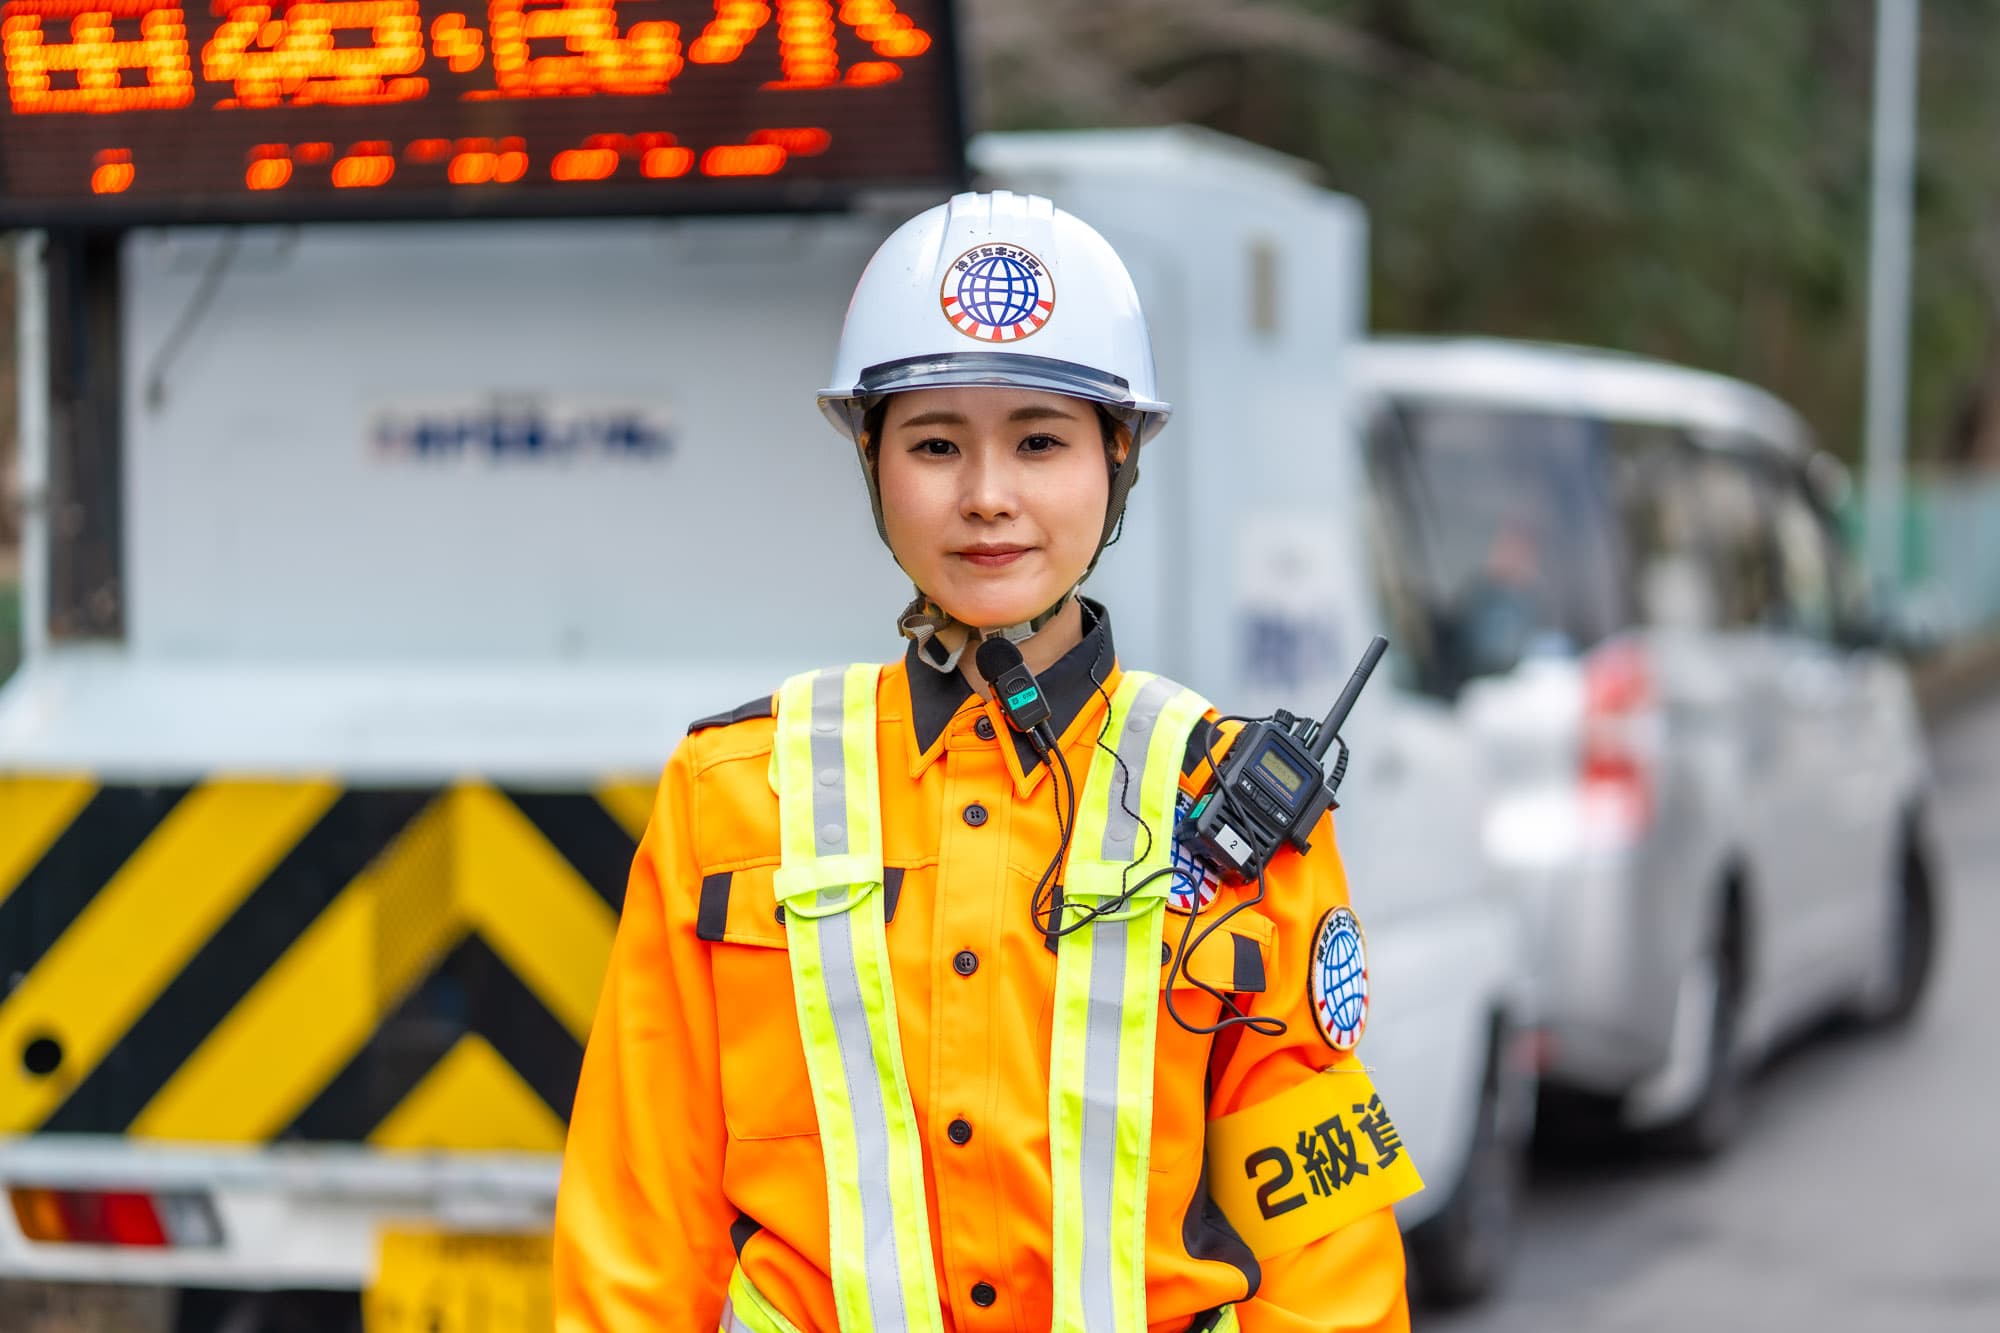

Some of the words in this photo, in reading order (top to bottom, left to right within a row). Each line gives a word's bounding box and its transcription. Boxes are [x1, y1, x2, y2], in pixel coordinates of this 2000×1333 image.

[954, 246, 1043, 277] 神戸セキュリティ
[1229, 840, 1238, 850] 2
